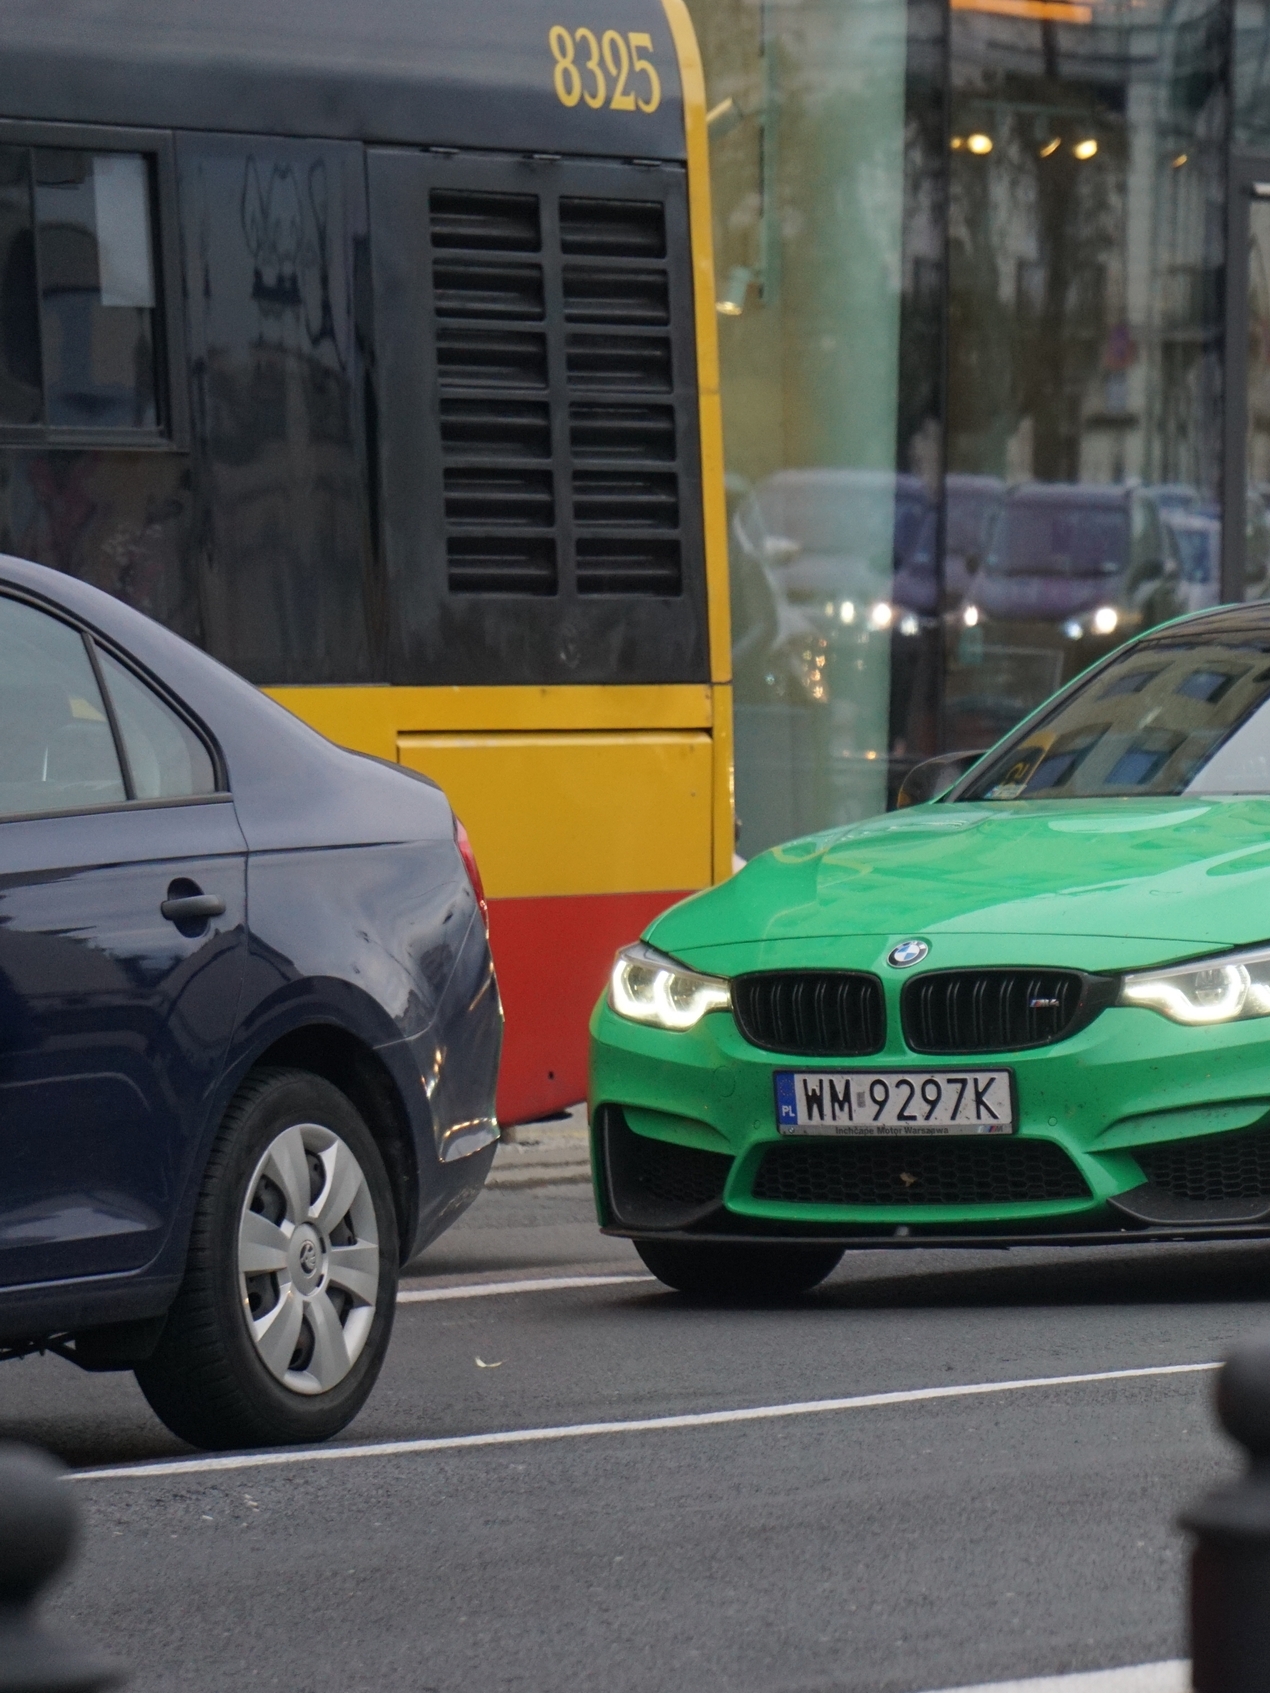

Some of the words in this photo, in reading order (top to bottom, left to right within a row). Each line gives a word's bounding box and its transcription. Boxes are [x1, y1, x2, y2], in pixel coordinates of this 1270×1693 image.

[548, 25, 661, 113] 8325
[782, 1105, 796, 1117] PL
[802, 1078, 853, 1121] WM
[869, 1077, 1000, 1121] 9297K
[877, 1126, 901, 1135] Motor
